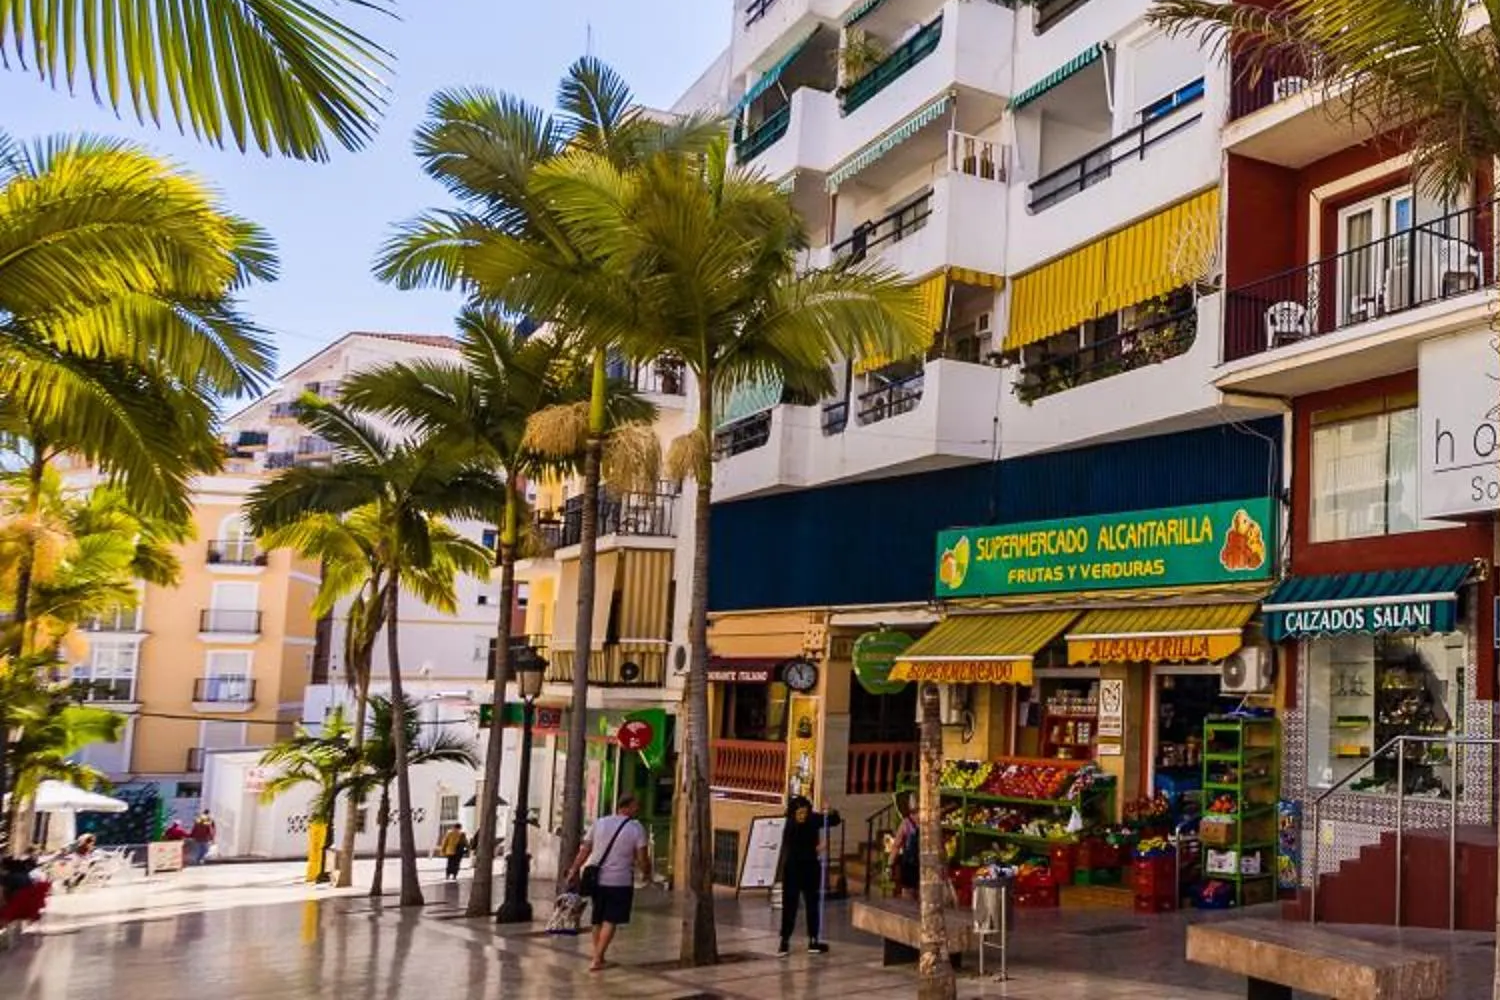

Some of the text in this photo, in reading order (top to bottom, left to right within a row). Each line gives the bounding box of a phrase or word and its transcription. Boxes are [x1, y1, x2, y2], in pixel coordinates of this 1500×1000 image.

[975, 515, 1213, 561] SUPERMERCADO ALCANTARILLA
[1007, 559, 1165, 585] FRUTAS Y VERDURAS
[1284, 603, 1432, 632] CALZADOS SALANI
[1088, 636, 1210, 660] ALCANTARILLA
[906, 660, 1013, 681] SUPERMERCADO
